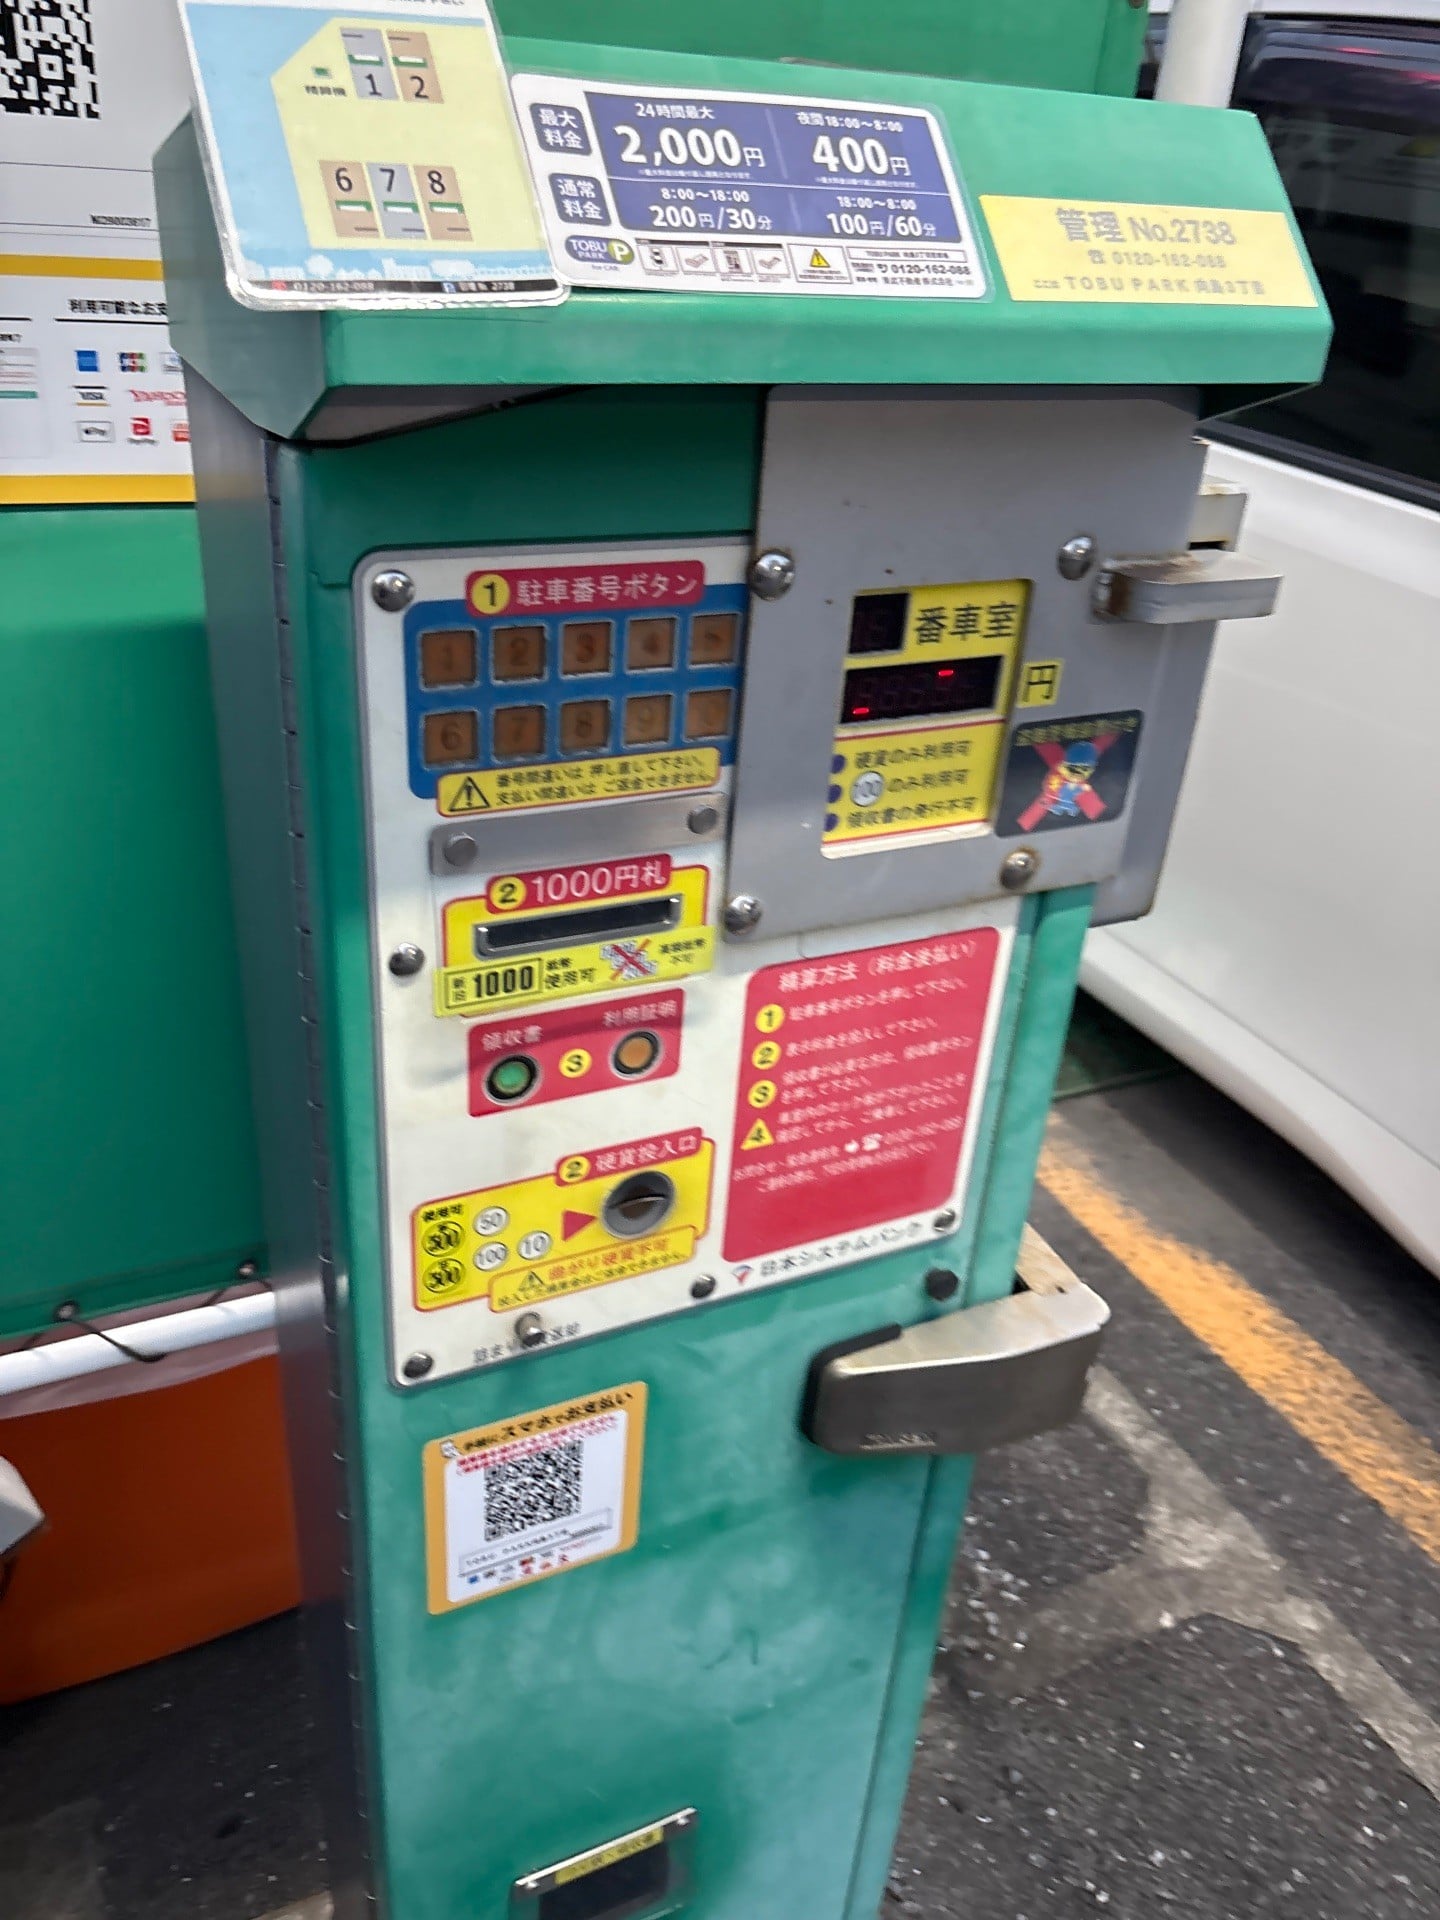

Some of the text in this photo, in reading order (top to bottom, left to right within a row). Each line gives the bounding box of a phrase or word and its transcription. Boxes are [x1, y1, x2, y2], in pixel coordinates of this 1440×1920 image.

[366, 74, 429, 98] 1 2
[539, 108, 578, 128] 最大
[543, 129, 583, 149] 料金
[613, 124, 766, 167] 2,000円
[813, 135, 911, 176] 400円
[335, 168, 445, 194] 6 7 8
[558, 179, 596, 199] 通常
[563, 199, 603, 220] 料金
[570, 239, 607, 251] TOBU
[517, 573, 698, 607] 駐車番号ボタン
[1023, 664, 1057, 702] 円
[499, 861, 666, 904] 2 1000円札
[472, 965, 534, 998] 1000
